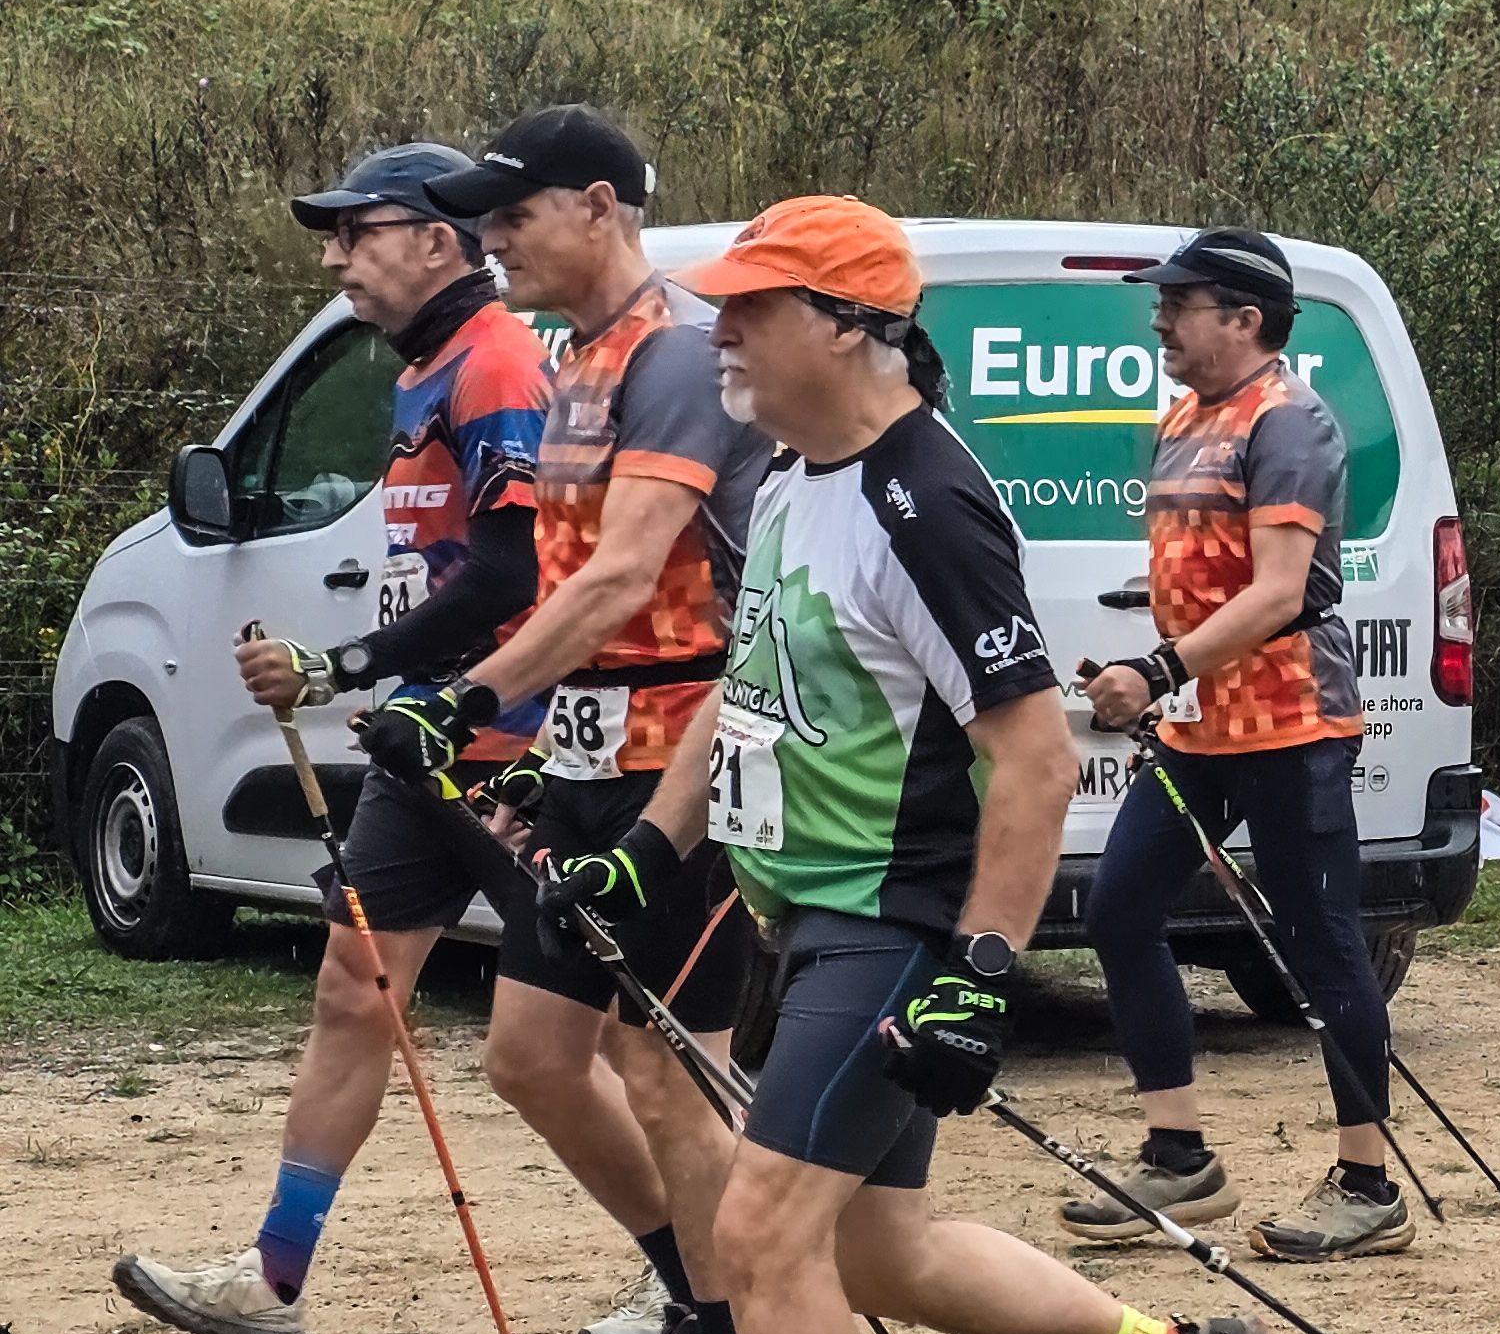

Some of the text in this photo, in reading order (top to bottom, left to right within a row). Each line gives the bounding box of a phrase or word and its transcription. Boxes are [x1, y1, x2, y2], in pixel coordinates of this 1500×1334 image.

[970, 327, 1323, 424] Europr
[1355, 618, 1412, 678] FIAT
[552, 695, 605, 752] 58
[1380, 694, 1424, 712] ahora
[709, 736, 743, 810] 21
